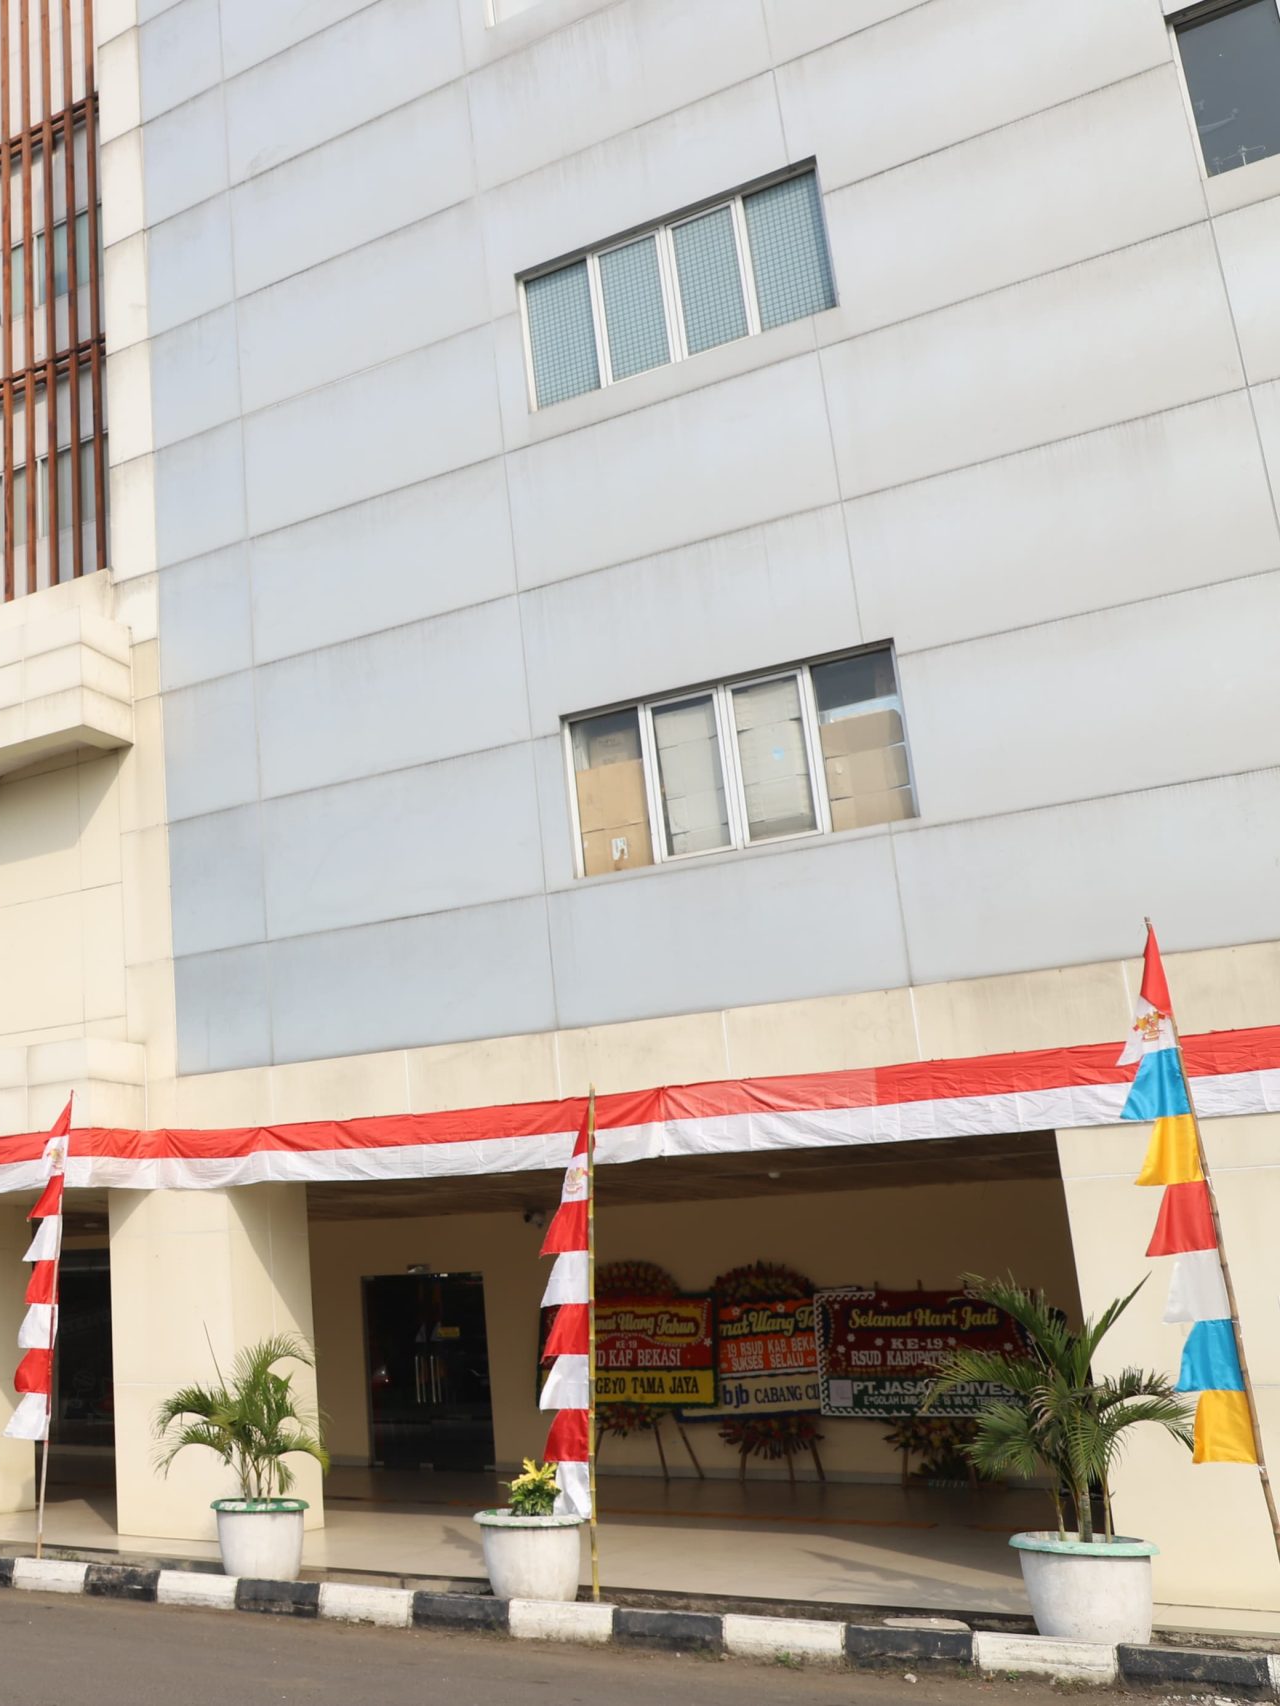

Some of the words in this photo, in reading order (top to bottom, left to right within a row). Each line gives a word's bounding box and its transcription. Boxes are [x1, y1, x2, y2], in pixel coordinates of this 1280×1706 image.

[656, 1314, 696, 1335] Tahun
[748, 1310, 795, 1337] Ulang
[848, 1308, 913, 1329] Selamat
[914, 1306, 958, 1327] Hari
[960, 1305, 1000, 1332] Jadi
[740, 1340, 764, 1356] RSUD
[790, 1335, 816, 1352] BEKA
[637, 1349, 681, 1366] BEKASI
[731, 1355, 764, 1371] SUKSES
[769, 1352, 805, 1368] SELALU
[850, 1350, 882, 1366] RSUD
[669, 1376, 700, 1394] JAYA
[722, 1382, 749, 1408] bjb
[754, 1385, 803, 1404] CABANG
